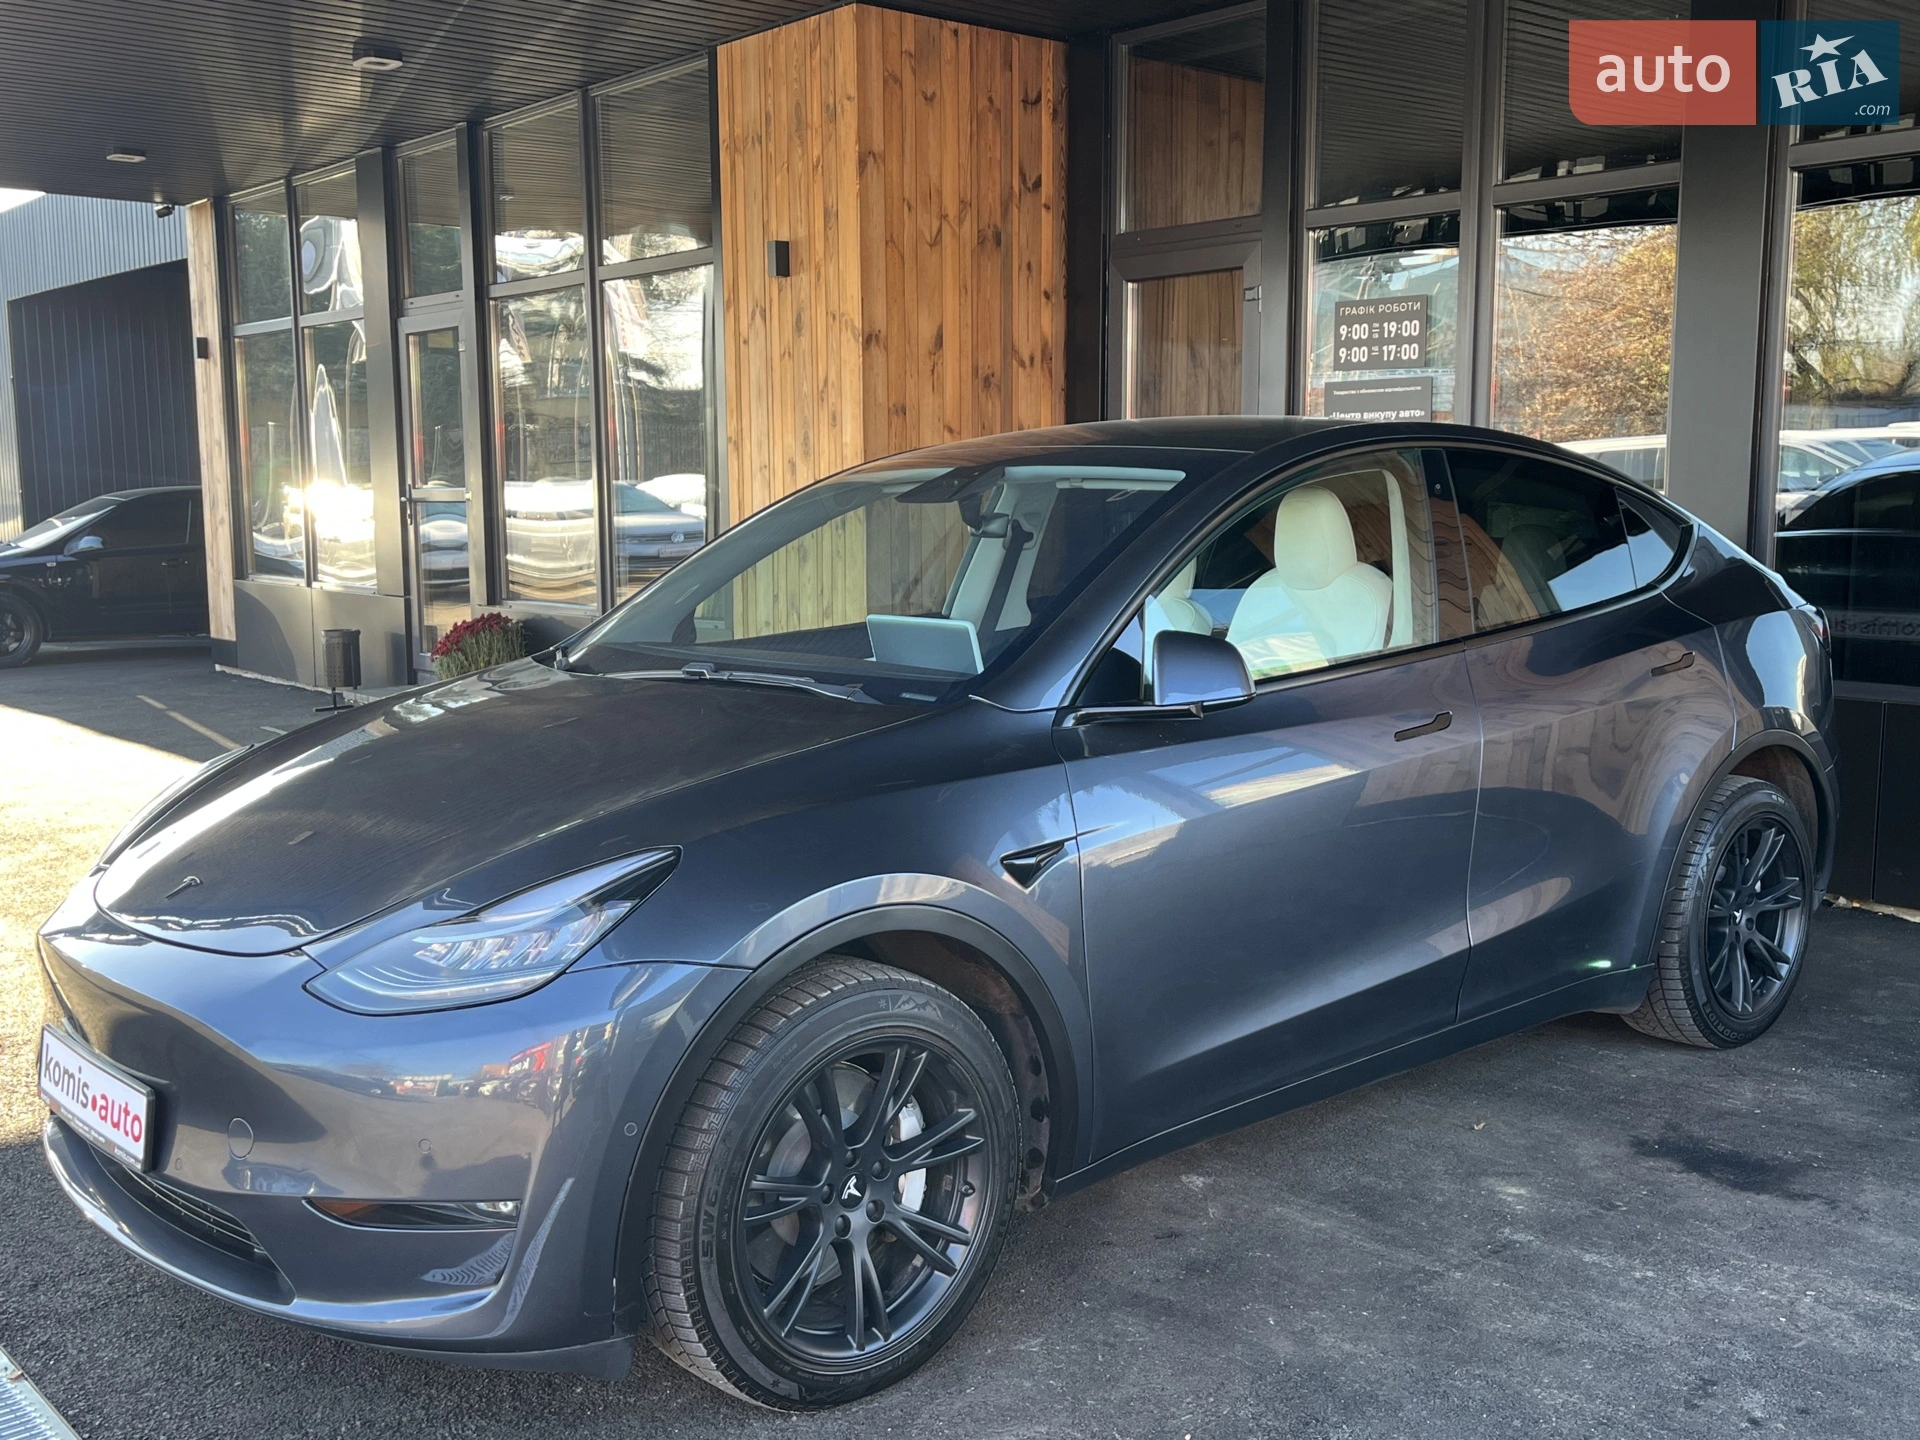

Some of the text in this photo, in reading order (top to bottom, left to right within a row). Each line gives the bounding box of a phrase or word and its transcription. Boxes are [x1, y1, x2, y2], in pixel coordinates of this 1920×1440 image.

[1339, 301, 1421, 317] ГРАФІК РОБОТИ
[1339, 319, 1420, 341] 9:00 19:00
[1339, 343, 1419, 364] 9:00 17:00
[1363, 410, 1397, 421] викупу
[1399, 409, 1425, 418] авто»
